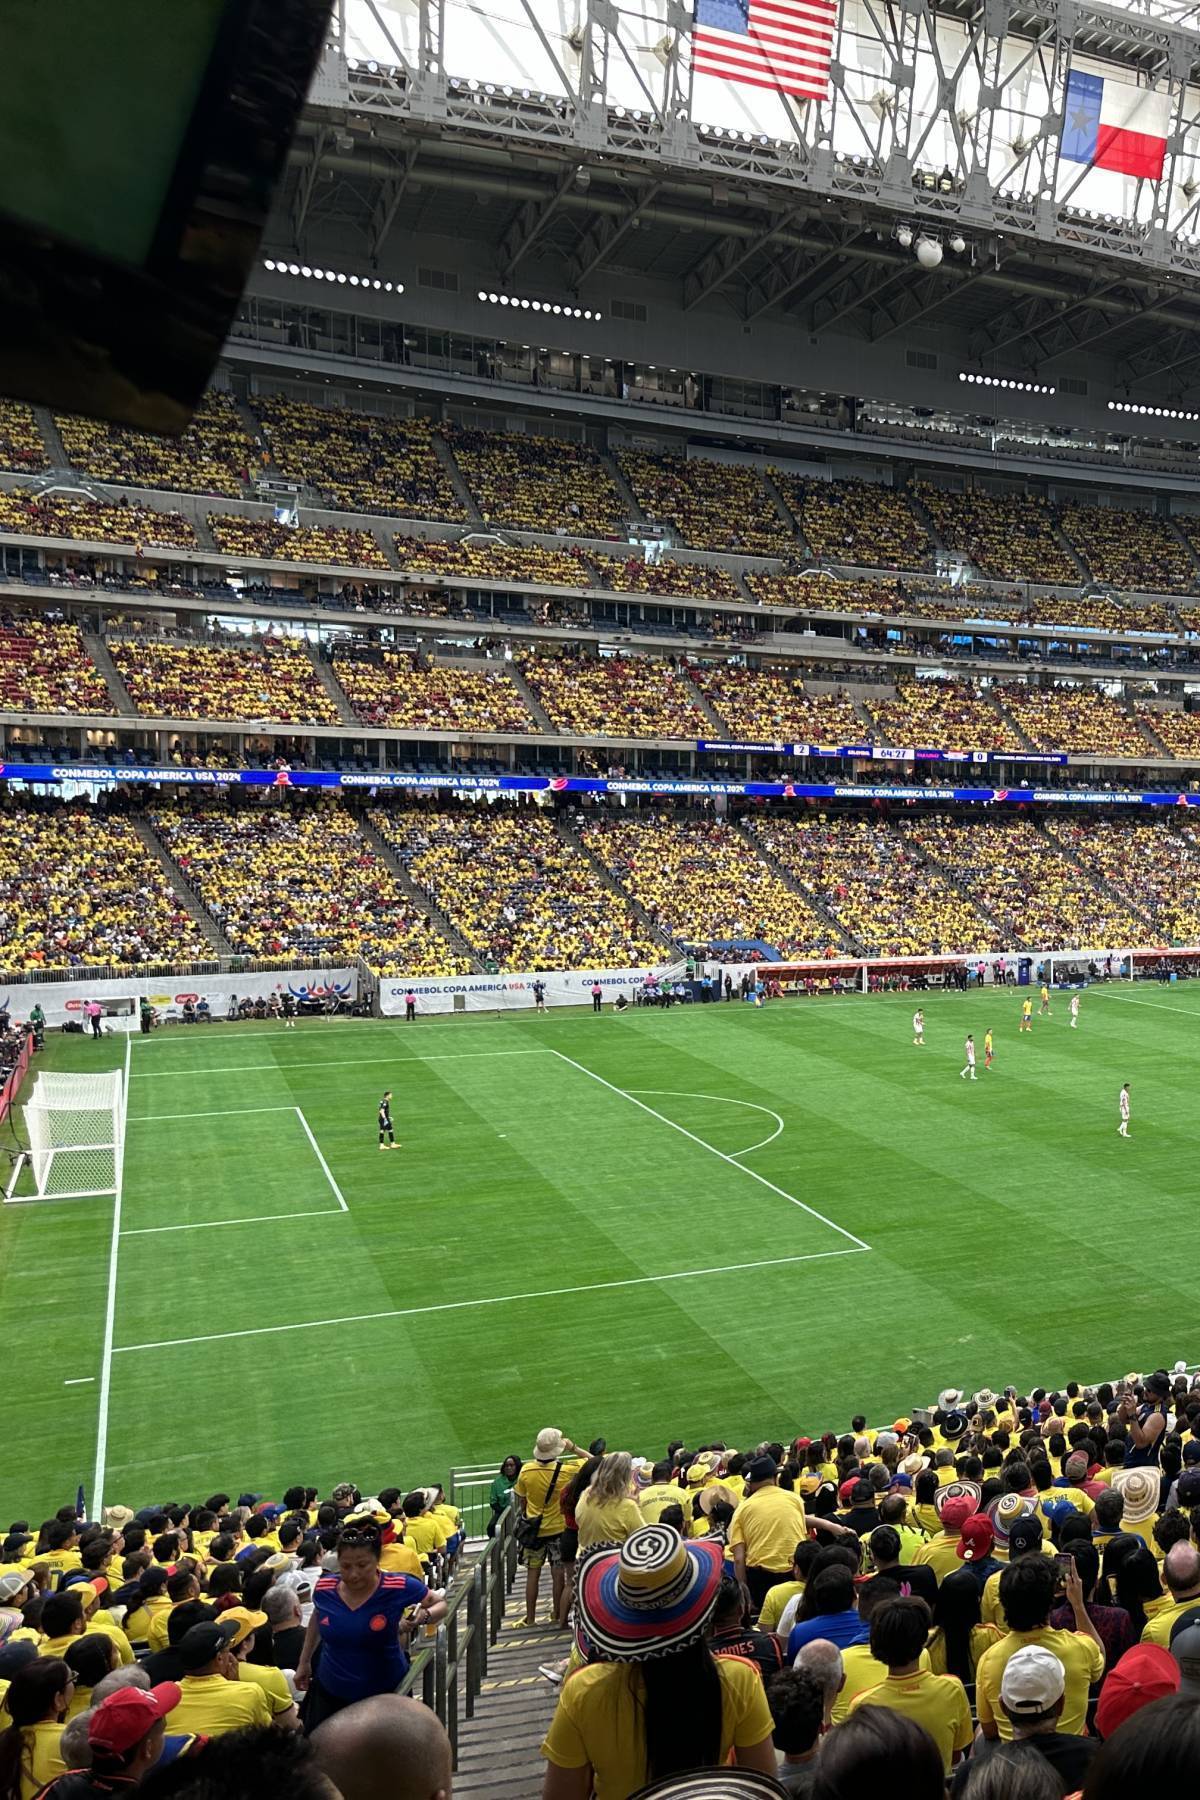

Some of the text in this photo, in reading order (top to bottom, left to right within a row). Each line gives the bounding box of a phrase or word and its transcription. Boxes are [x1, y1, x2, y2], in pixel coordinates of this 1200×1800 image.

[799, 746, 805, 754] 2
[880, 750, 906, 758] 64:27
[977, 753, 983, 761] 0
[52, 768, 241, 782] CONMEBOL COPA AMERICA USA 2024
[340, 775, 499, 788] CONMEBOL COPA AMERICA USA 2024
[607, 781, 652, 791] CONMEBOL
[653, 782, 675, 792] COPA
[675, 782, 710, 793] AMERICA
[834, 787, 874, 797] CONMEBOL
[874, 788, 894, 797] COPA
[443, 985, 467, 993] COPA
[468, 983, 507, 993] AMERICA
[508, 982, 525, 990] USA
